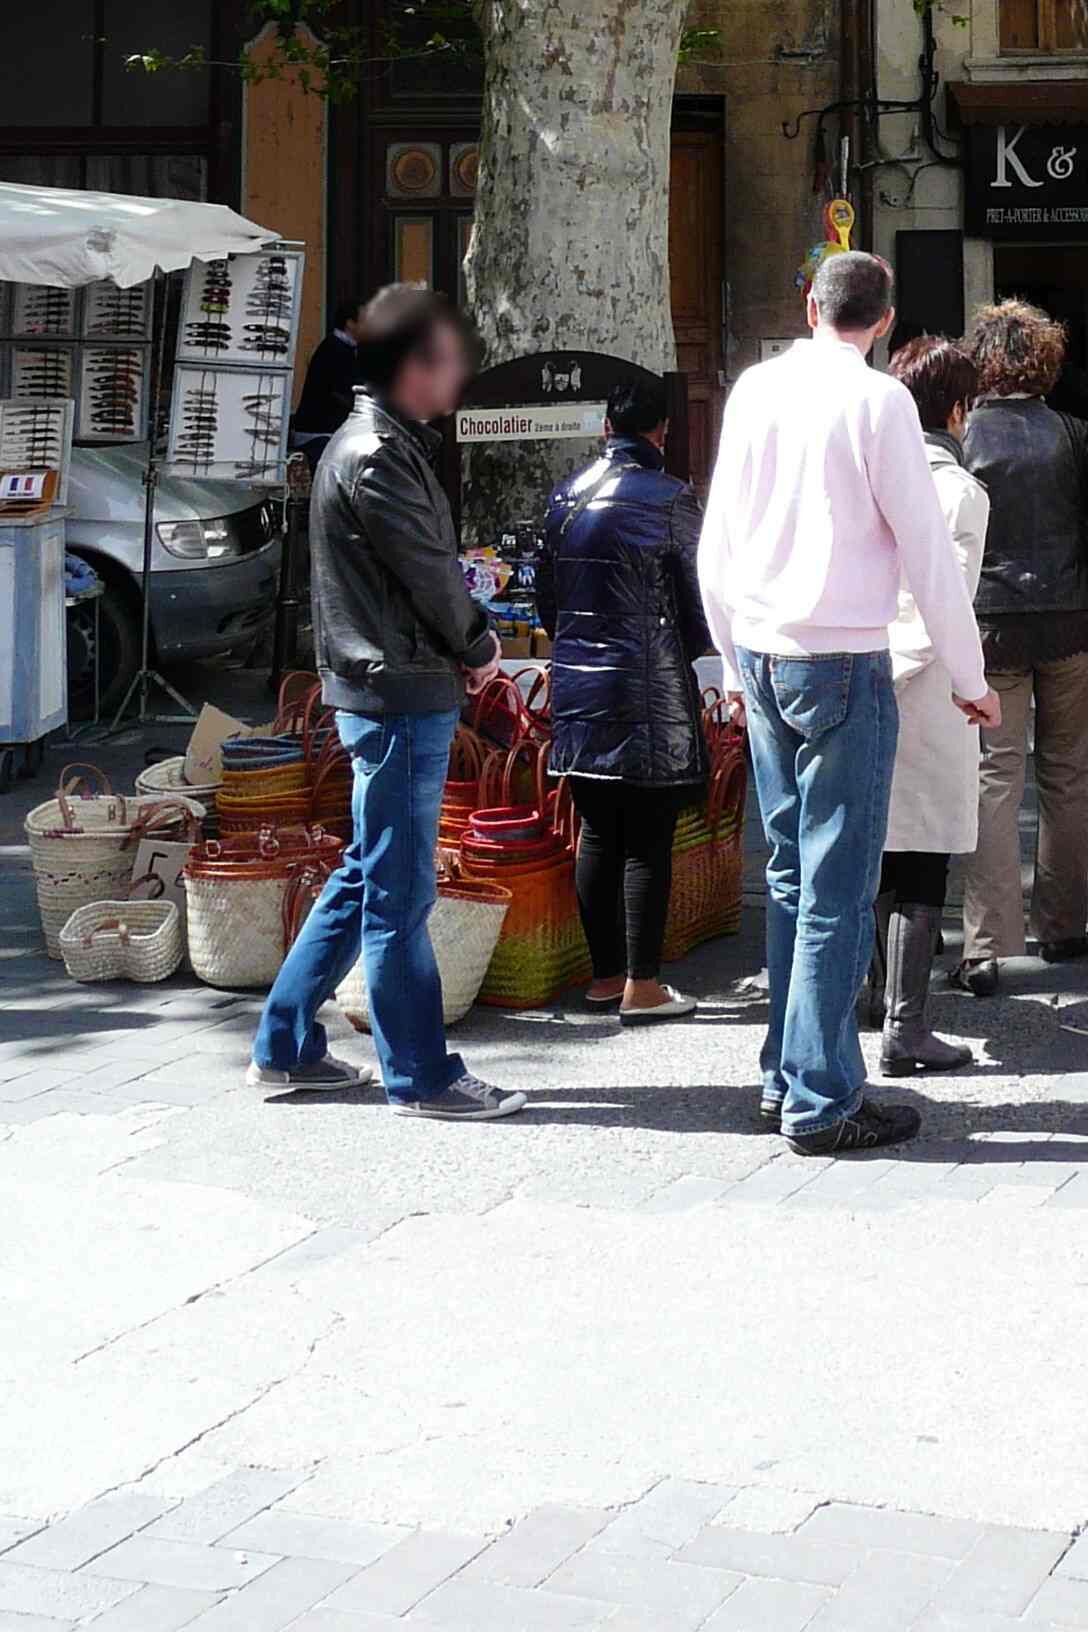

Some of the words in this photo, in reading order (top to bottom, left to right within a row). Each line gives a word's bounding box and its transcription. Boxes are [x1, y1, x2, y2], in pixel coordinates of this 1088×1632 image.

[990, 125, 1045, 188] K
[1046, 146, 1077, 179] &
[460, 415, 532, 436] Chocolatier
